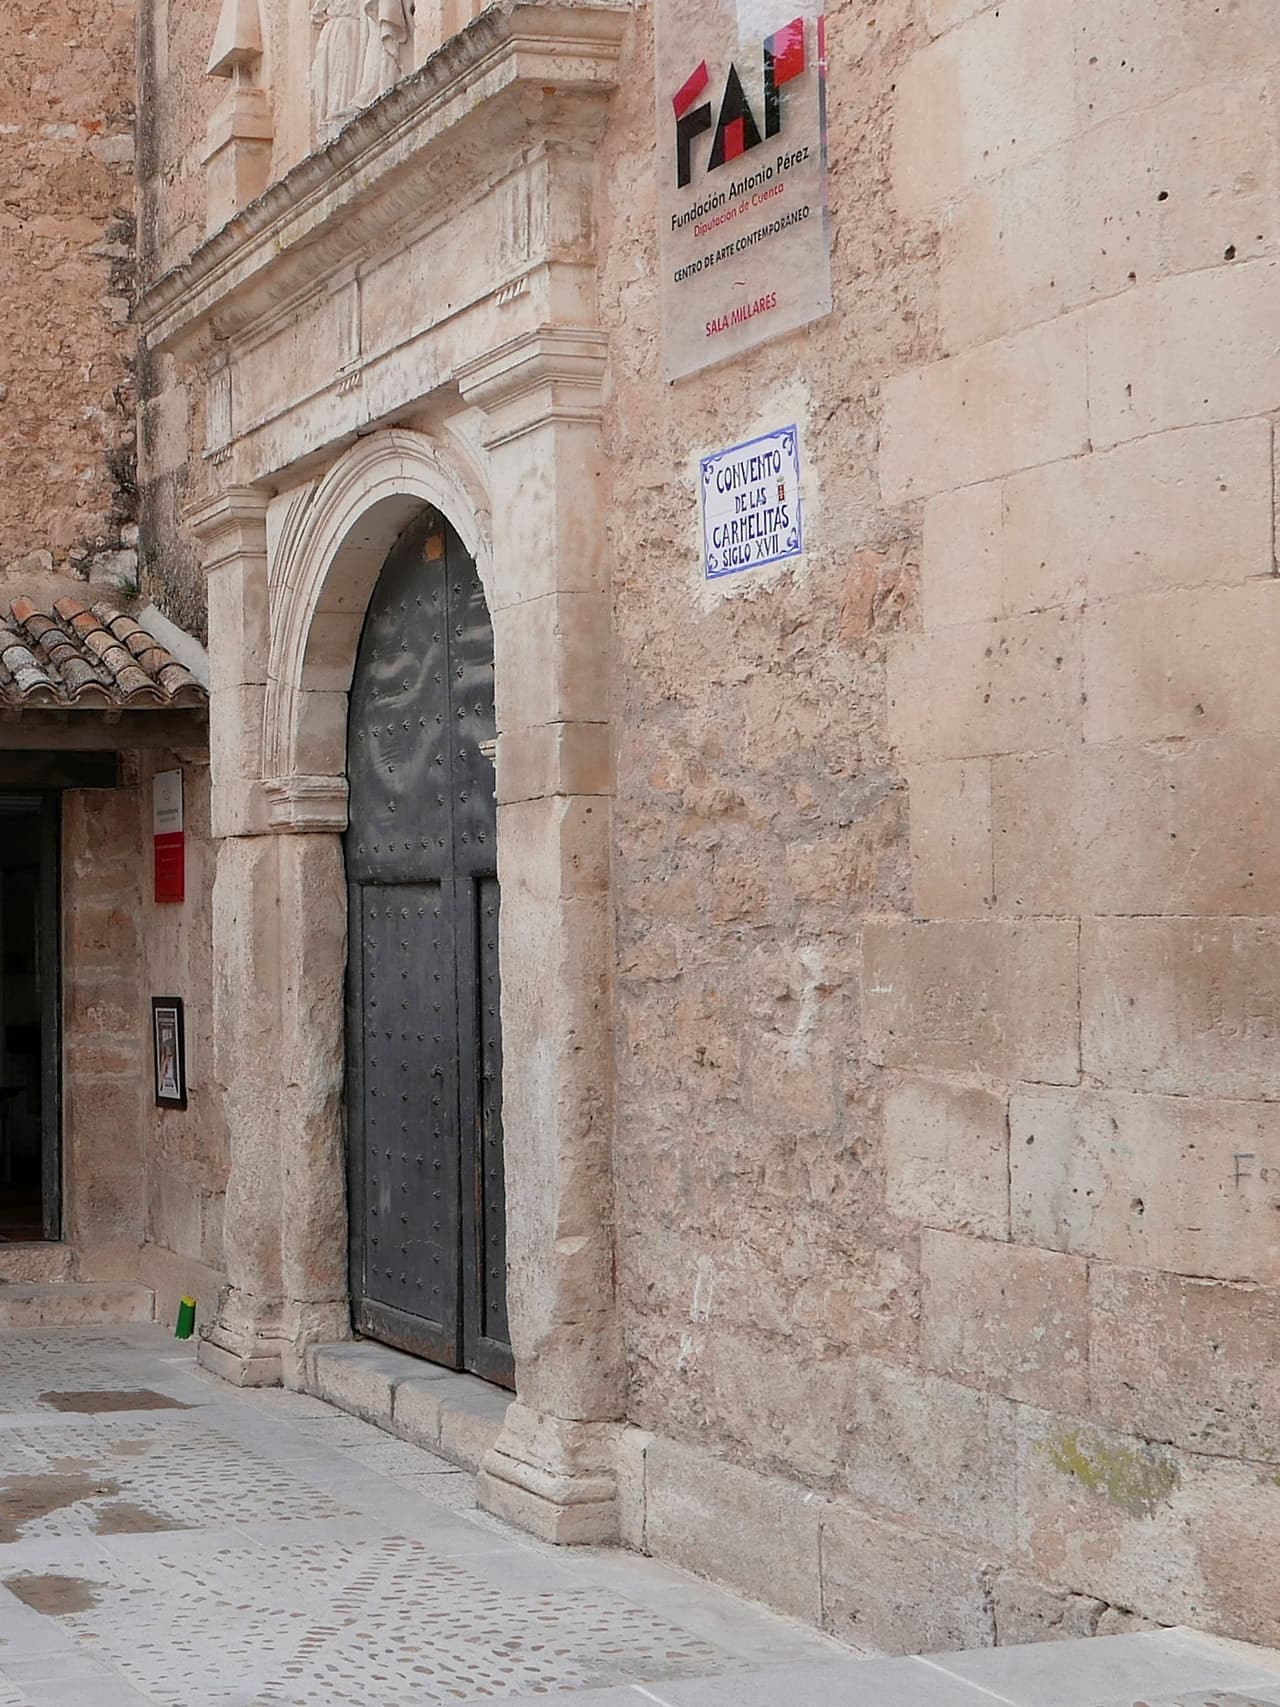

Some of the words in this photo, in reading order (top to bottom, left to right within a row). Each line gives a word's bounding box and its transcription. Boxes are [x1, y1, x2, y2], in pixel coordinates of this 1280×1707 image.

[671, 192, 725, 231] Fundación
[729, 164, 773, 201] Antonio
[777, 146, 810, 174] Pérez
[739, 200, 749, 214] de
[674, 260, 703, 283] CENTRO
[704, 254, 715, 268] DE
[715, 243, 735, 263] ARTE
[735, 205, 810, 252] CONTEMPORANEO
[705, 314, 729, 337] SALA
[731, 291, 777, 326] MILLARES
[716, 449, 782, 494] CONVENTO
[735, 494, 747, 514] DE
[750, 487, 767, 508] LAS
[712, 504, 790, 549] CARMELITAS
[722, 543, 751, 567] SIGLO
[755, 534, 779, 559] XVII
